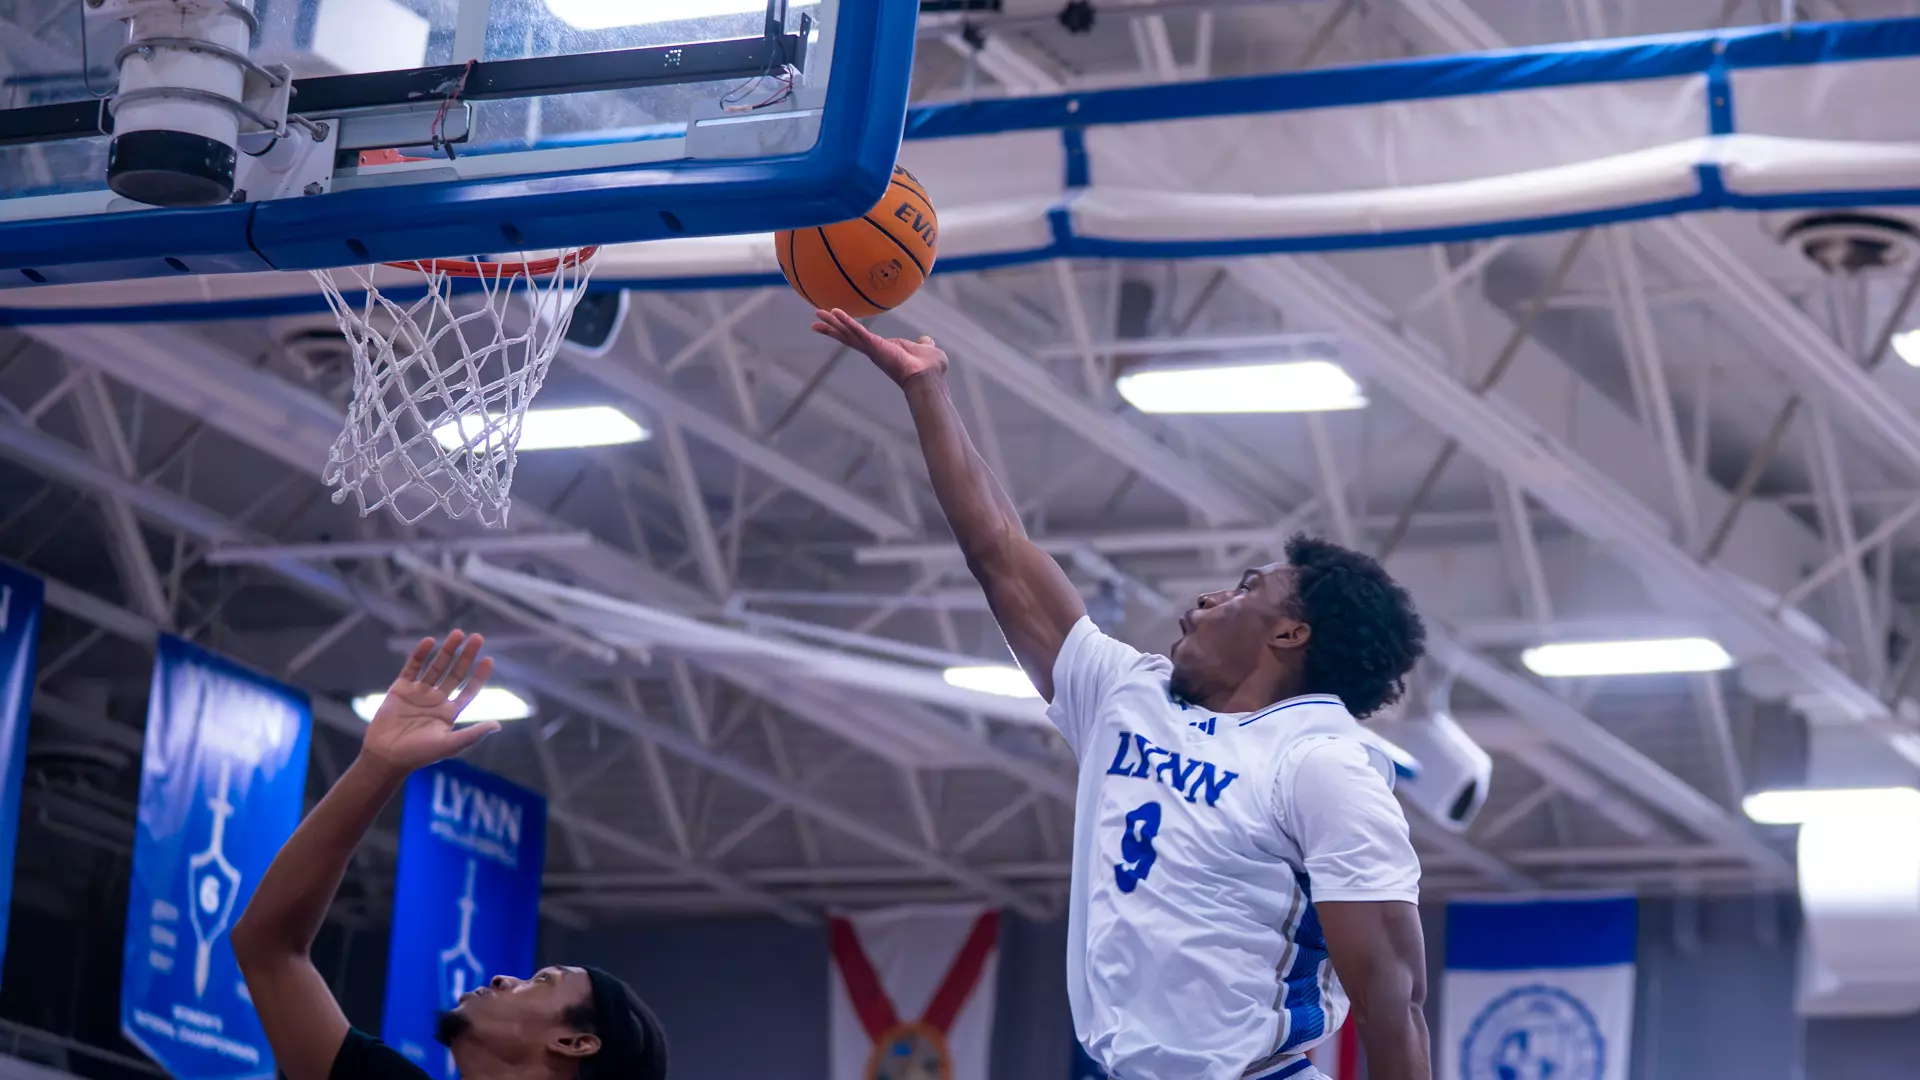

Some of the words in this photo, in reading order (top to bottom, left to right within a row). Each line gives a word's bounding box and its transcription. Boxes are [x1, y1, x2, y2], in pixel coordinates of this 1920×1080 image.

[1106, 731, 1239, 807] LYNN
[433, 771, 521, 845] LYNN
[1114, 801, 1161, 893] 9
